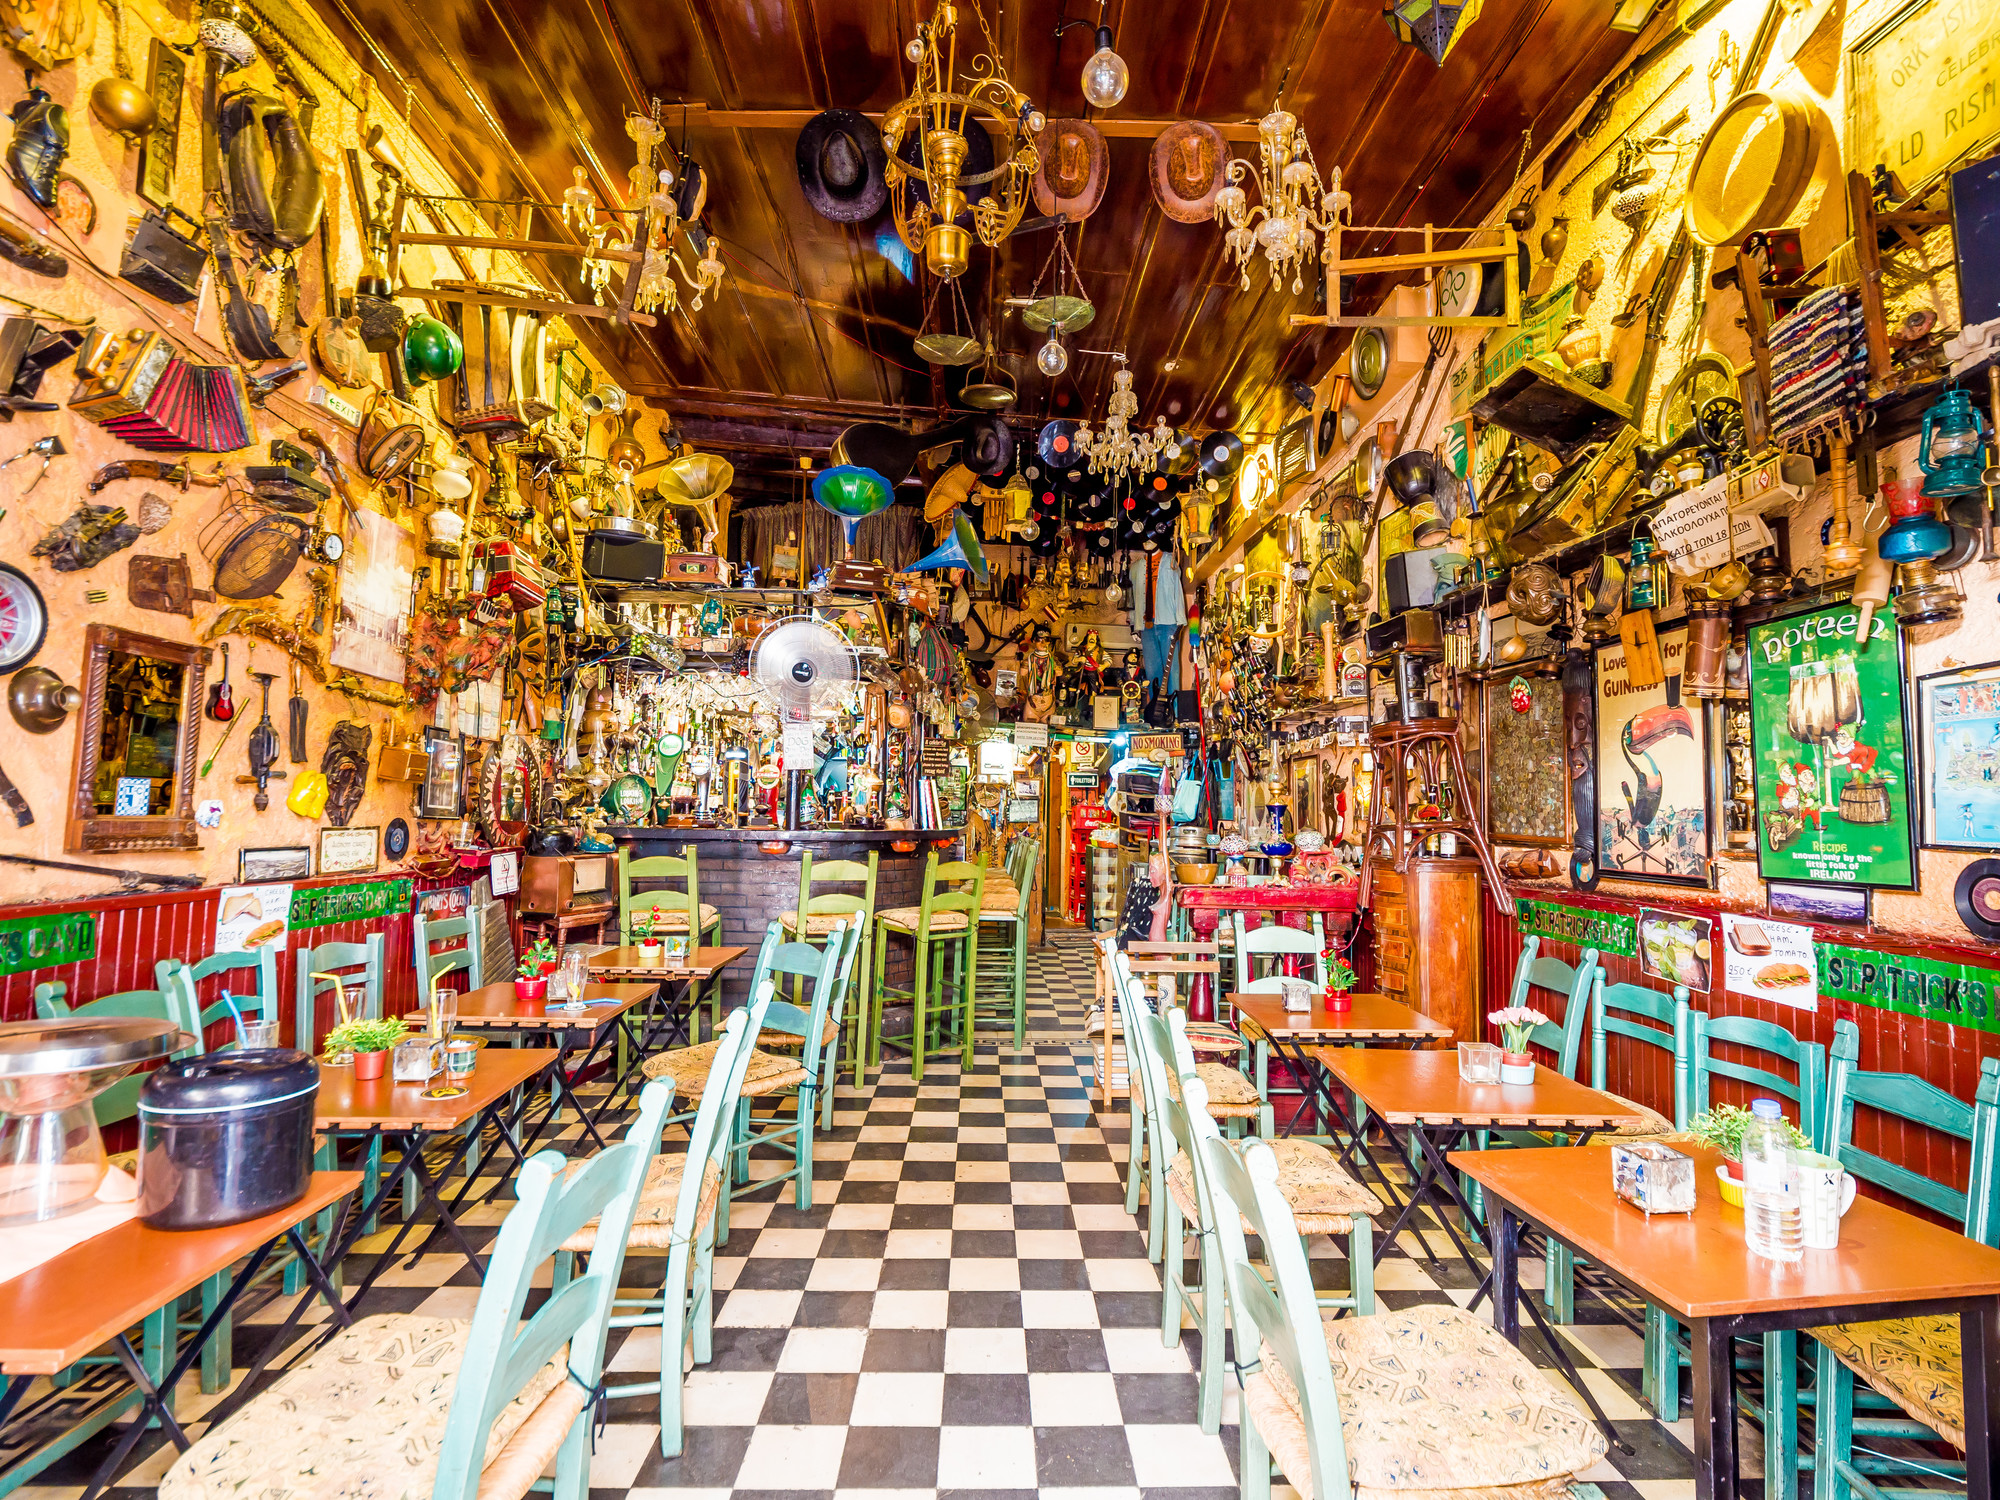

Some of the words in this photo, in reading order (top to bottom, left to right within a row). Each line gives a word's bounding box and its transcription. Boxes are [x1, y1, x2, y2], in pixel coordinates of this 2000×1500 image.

[335, 401, 355, 419] EXIT
[1651, 492, 1723, 532] ΑΠΑΓΟΡΕΥΟΝΤΑΙ
[1668, 544, 1693, 560] ΚΑΤΩ
[1694, 535, 1714, 550] ΤΩΝ
[1715, 529, 1727, 541] 18
[1732, 519, 1751, 534] ΤΩΝ
[1663, 642, 1684, 659] for
[788, 737, 809, 746] DOG
[1132, 736, 1144, 750] NO
[1144, 736, 1180, 749] SMOKING
[1811, 840, 1848, 854] Recipe
[1792, 852, 1821, 860] known
[1822, 853, 1841, 862] only
[1843, 854, 1855, 862] by
[1856, 854, 1873, 863] the
[1805, 860, 1827, 868] little
[1828, 861, 1847, 870] folk
[1848, 862, 1860, 870] of
[1809, 869, 1857, 881] IRELAND
